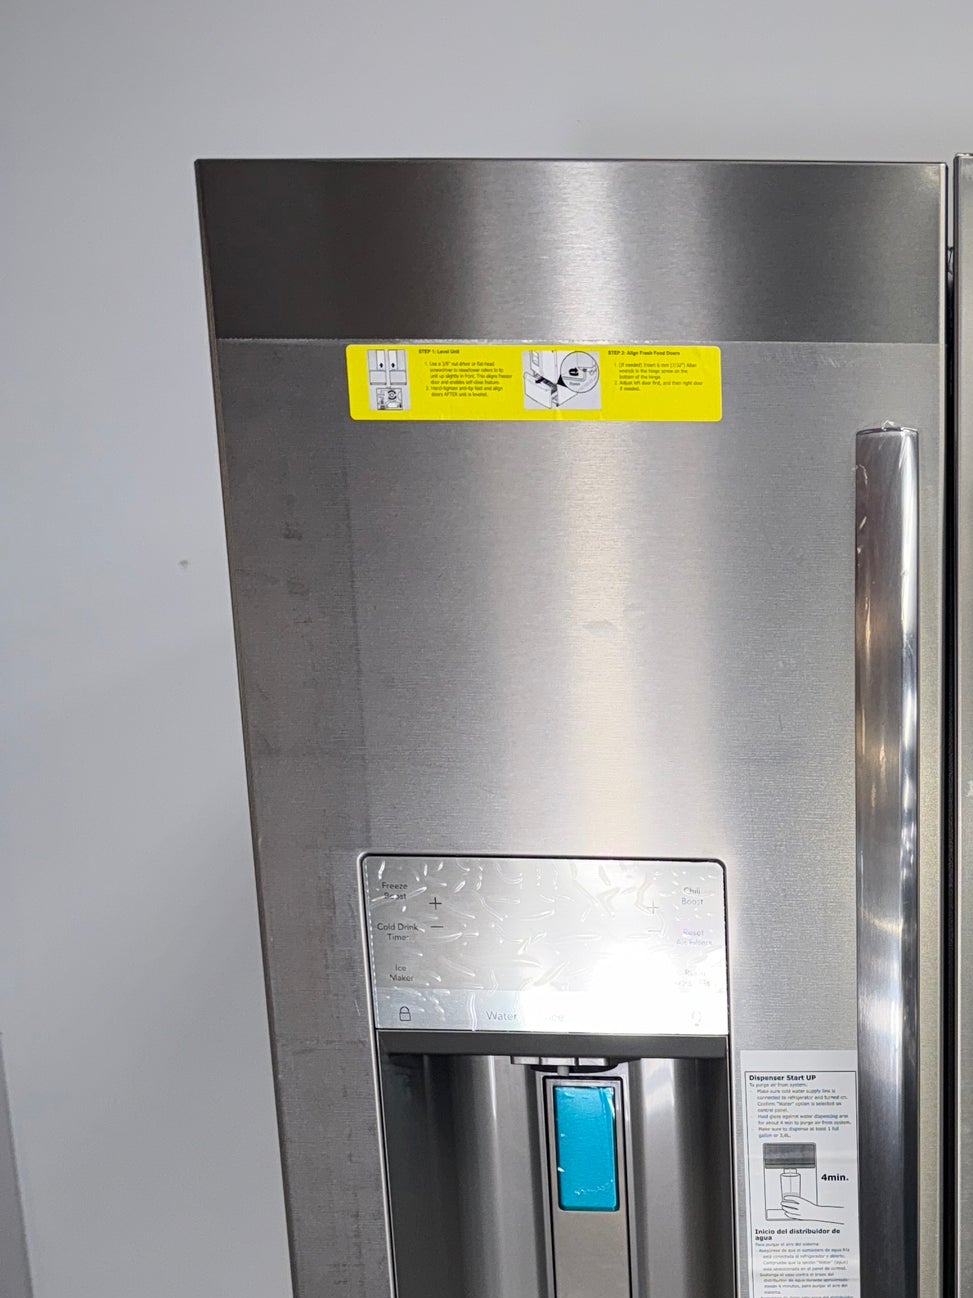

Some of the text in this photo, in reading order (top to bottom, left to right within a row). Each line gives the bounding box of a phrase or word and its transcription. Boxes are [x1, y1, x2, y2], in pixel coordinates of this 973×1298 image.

[382, 882, 408, 890] Freeze
[377, 923, 418, 931] Cold Drink
[395, 964, 407, 972] Ice
[389, 974, 414, 982] Maker
[486, 1011, 517, 1020] Water
